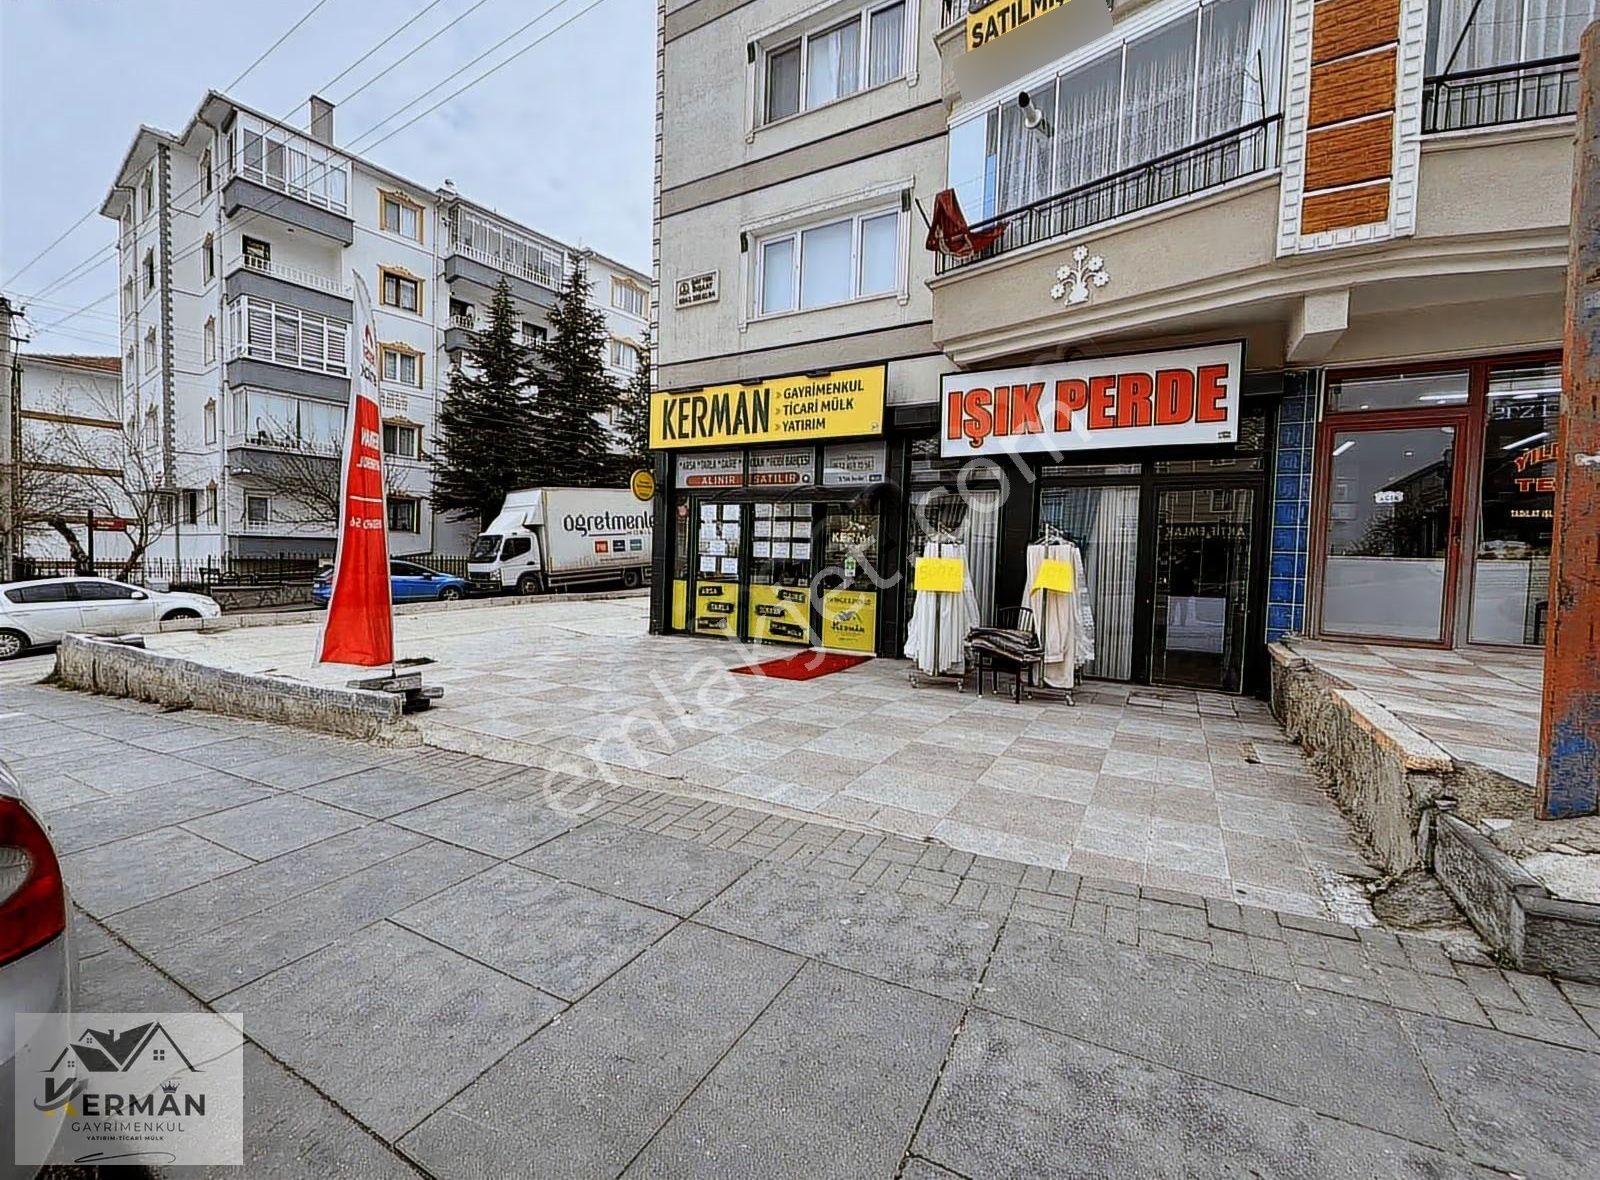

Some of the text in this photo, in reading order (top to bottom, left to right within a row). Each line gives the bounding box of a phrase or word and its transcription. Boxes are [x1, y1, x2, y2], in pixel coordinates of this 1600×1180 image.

[783, 379, 864, 400] GAYRİMENKUL
[662, 387, 770, 440] KERMAN
[783, 398, 854, 416] TİCARİ MÜLK
[947, 363, 1229, 448] IŞIK PERDE
[782, 417, 826, 432] YATIRIM
